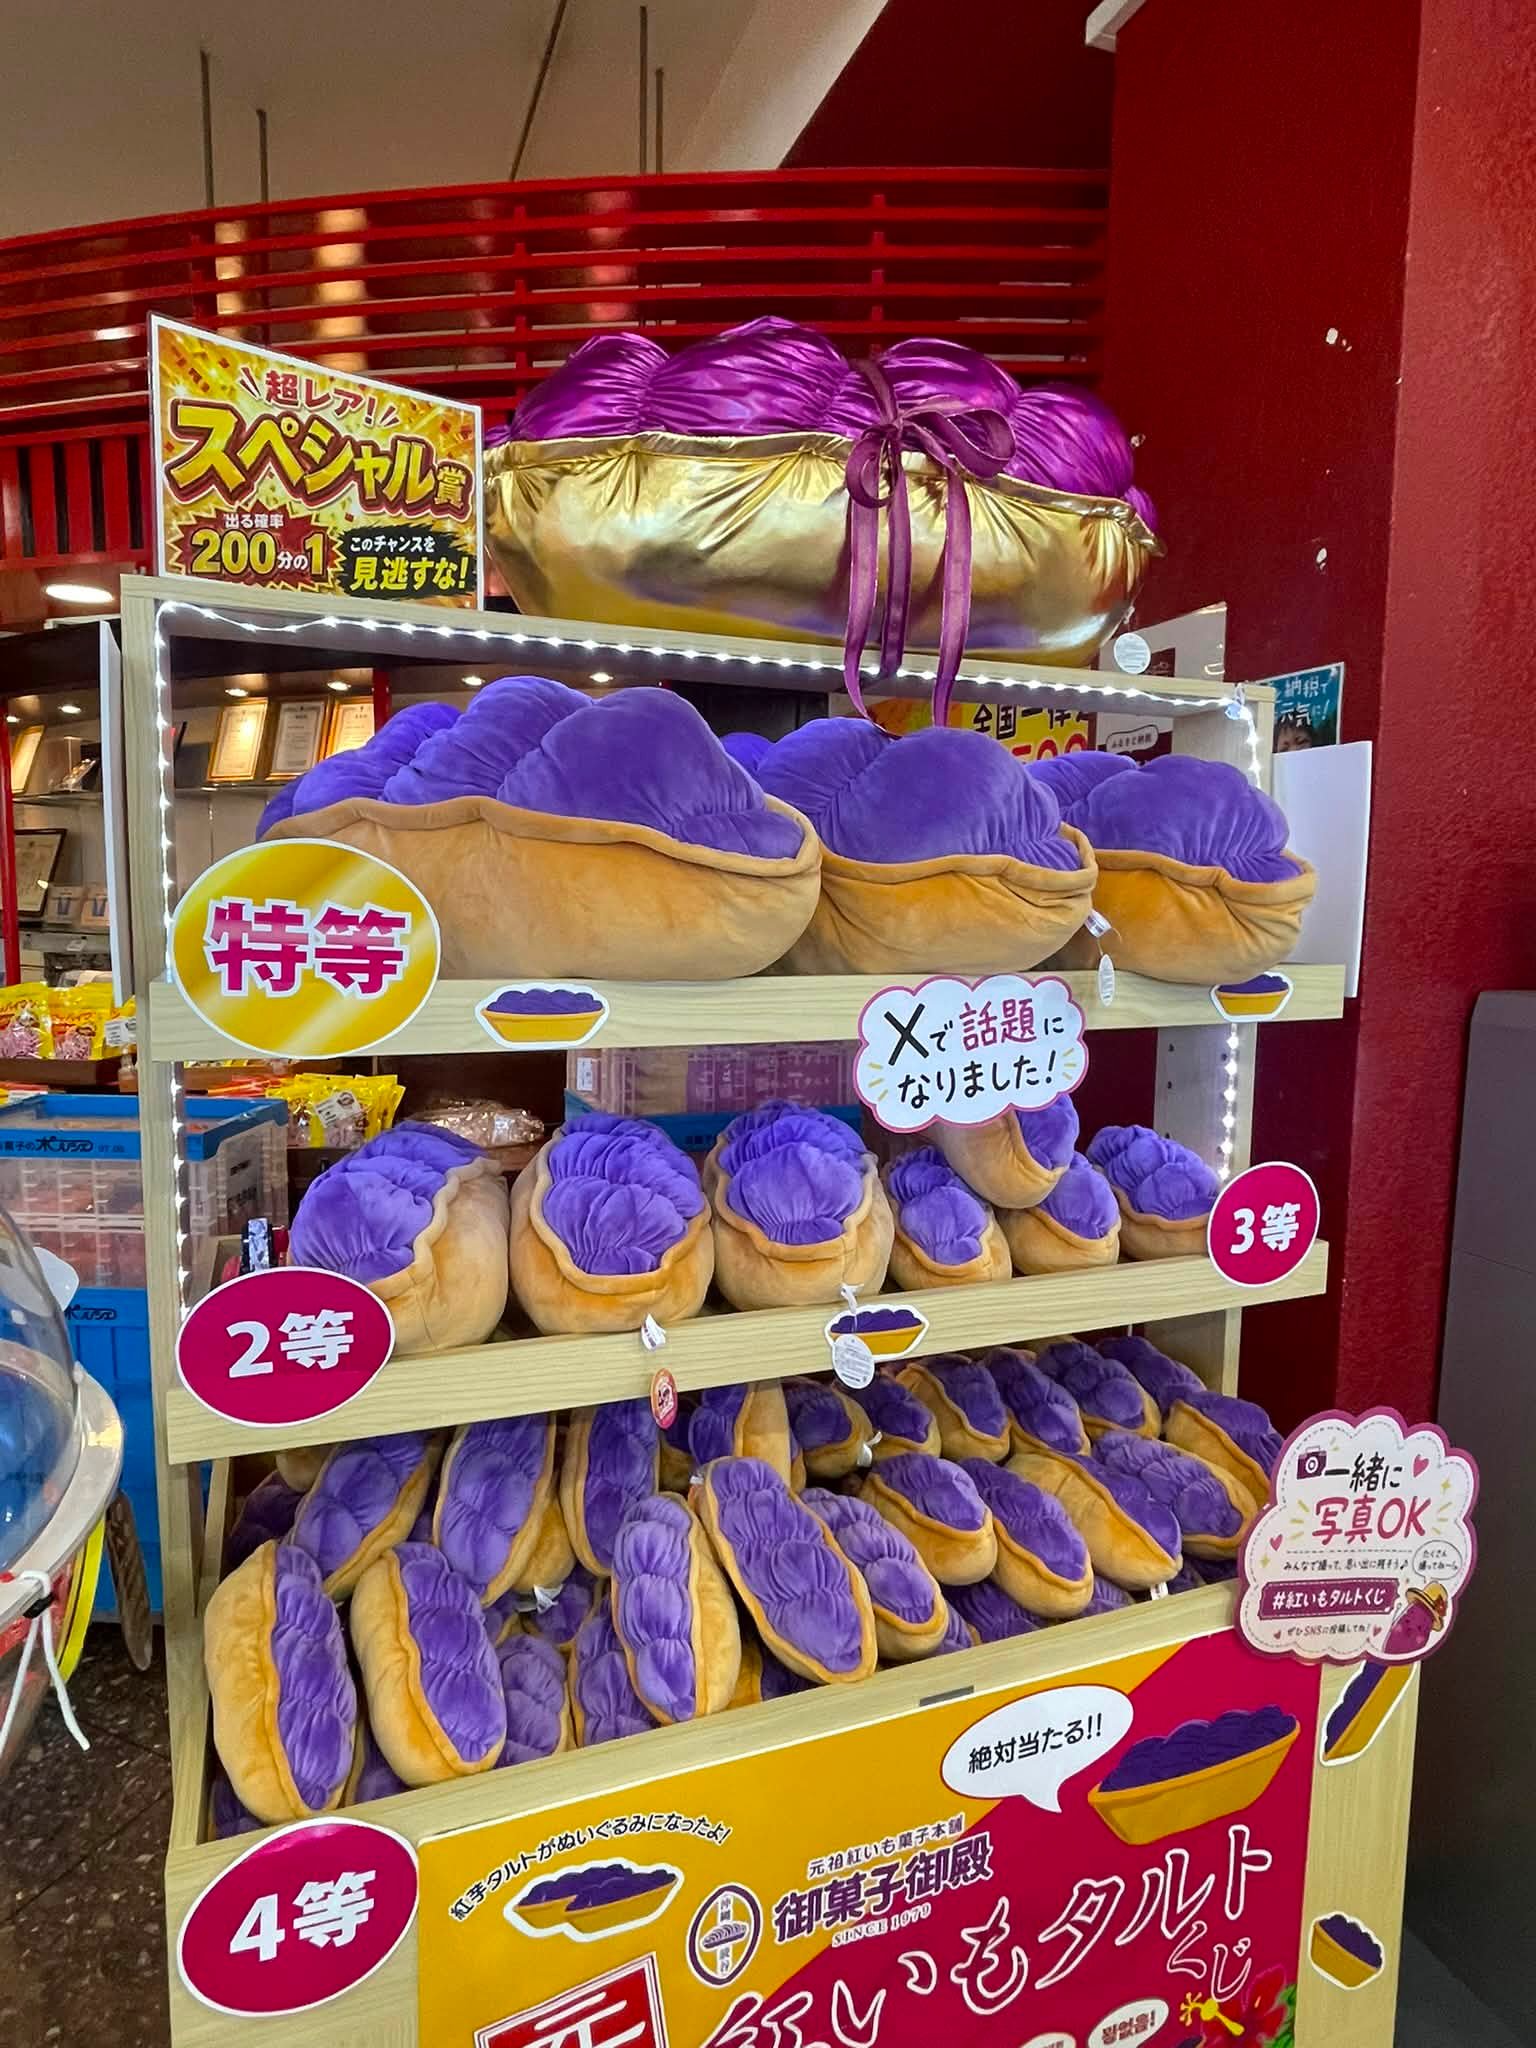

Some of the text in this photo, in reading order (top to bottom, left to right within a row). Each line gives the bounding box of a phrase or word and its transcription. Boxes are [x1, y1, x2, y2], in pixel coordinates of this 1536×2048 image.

[265, 370, 377, 426] 超レア!
[166, 402, 470, 512] スペシャル賞
[223, 512, 285, 529] 出る確率
[350, 534, 436, 554] このチャンスを
[190, 527, 327, 576] 200分の1
[350, 555, 468, 592] 見逃すな!
[205, 898, 409, 997] 特等
[883, 998, 1065, 1066] Xで話題に
[897, 1049, 1057, 1110] なりました!
[1229, 1201, 1301, 1255] 3等
[225, 1308, 355, 1380] 2等
[1323, 1451, 1404, 1493] 一緒に
[1311, 1494, 1432, 1546] 写真OK
[1272, 1587, 1386, 1611] #紅いもタルトくじ
[967, 1712, 1104, 1771] 絶対当たる!!
[450, 1813, 732, 1920] 紅芋タルトがぬいぐるみになったよ!
[808, 1814, 964, 1879] 元祖紅いも菓子本舗
[229, 1869, 377, 1963] 4等
[773, 1833, 993, 1943] 御菓子御殿
[833, 1903, 932, 1948] SINCE 1979
[1166, 1921, 1254, 2004] くじ
